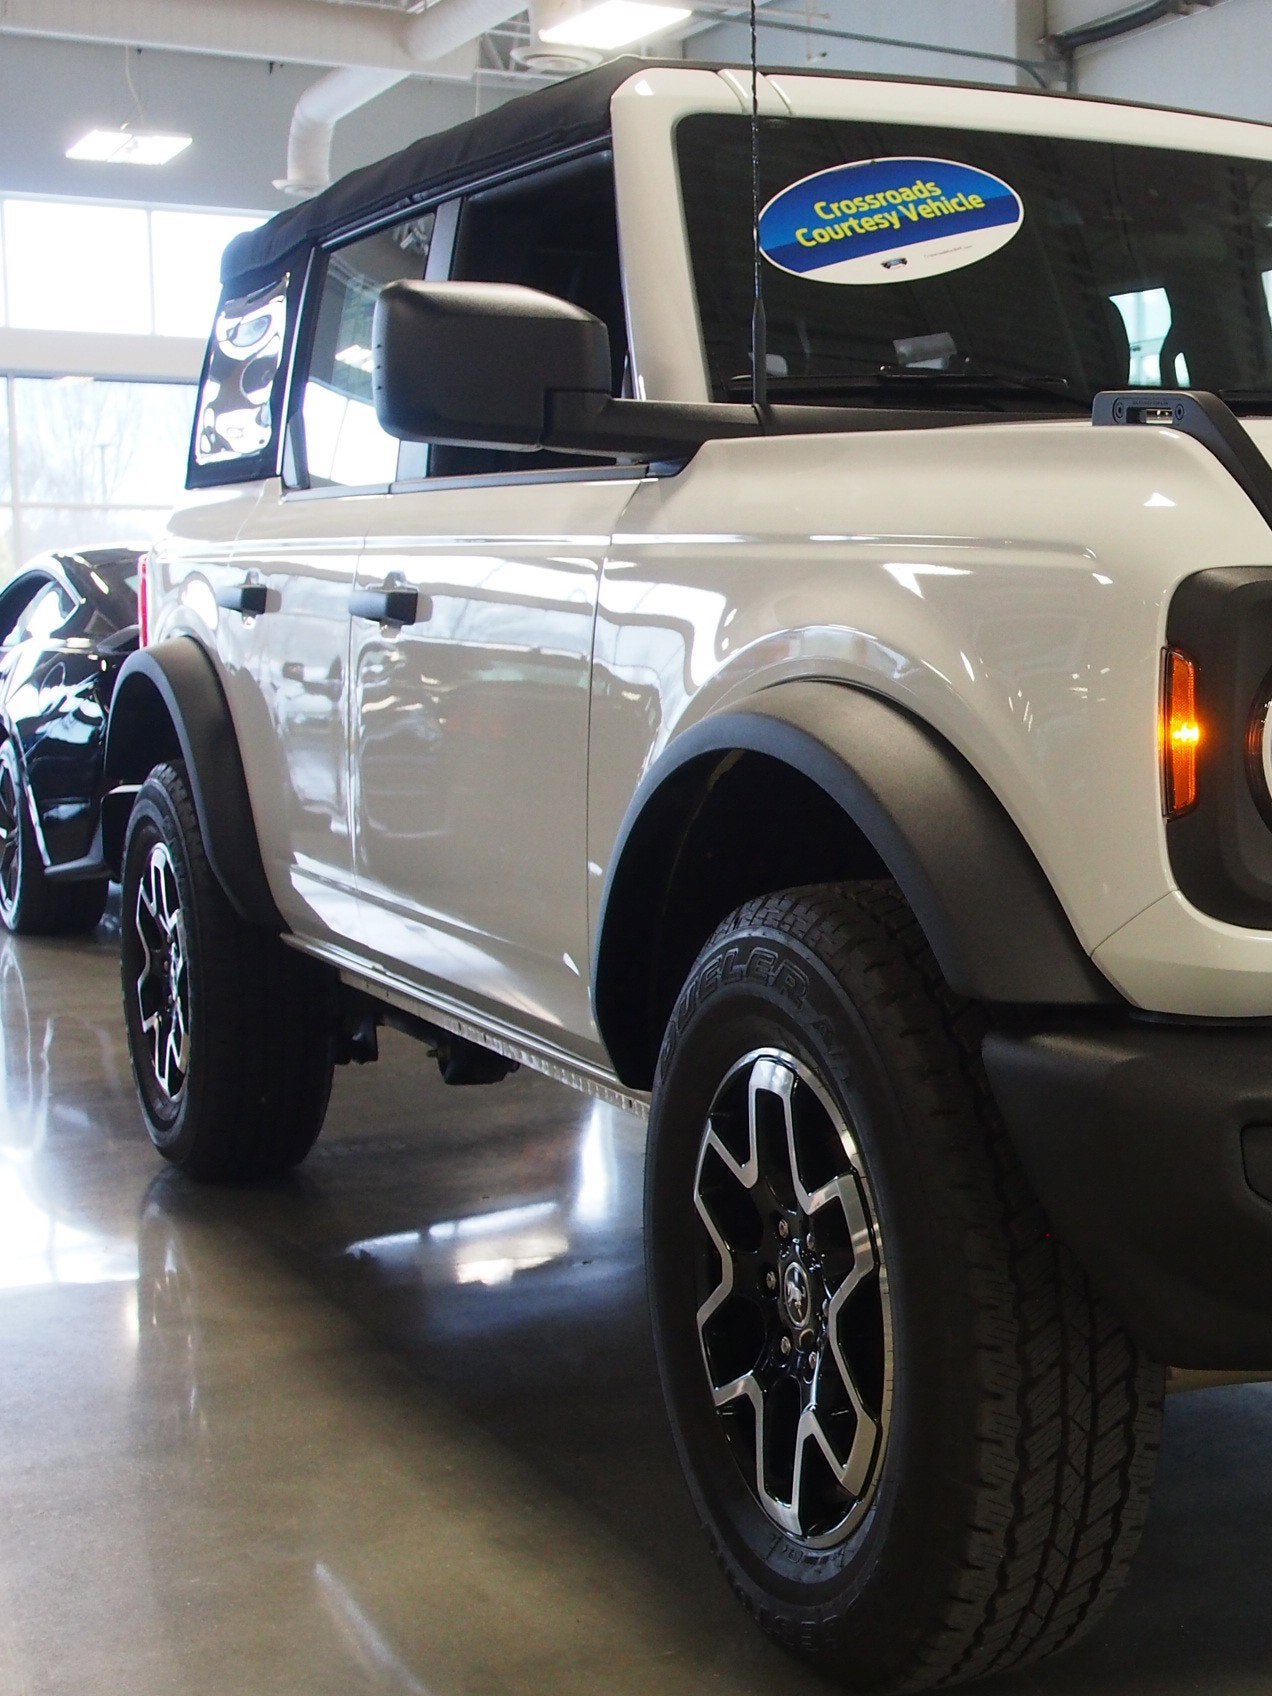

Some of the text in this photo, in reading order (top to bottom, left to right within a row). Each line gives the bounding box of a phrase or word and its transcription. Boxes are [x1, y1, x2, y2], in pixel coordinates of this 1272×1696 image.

[795, 192, 986, 247] Courtesy Vehicle
[813, 180, 942, 220] Crossroads
